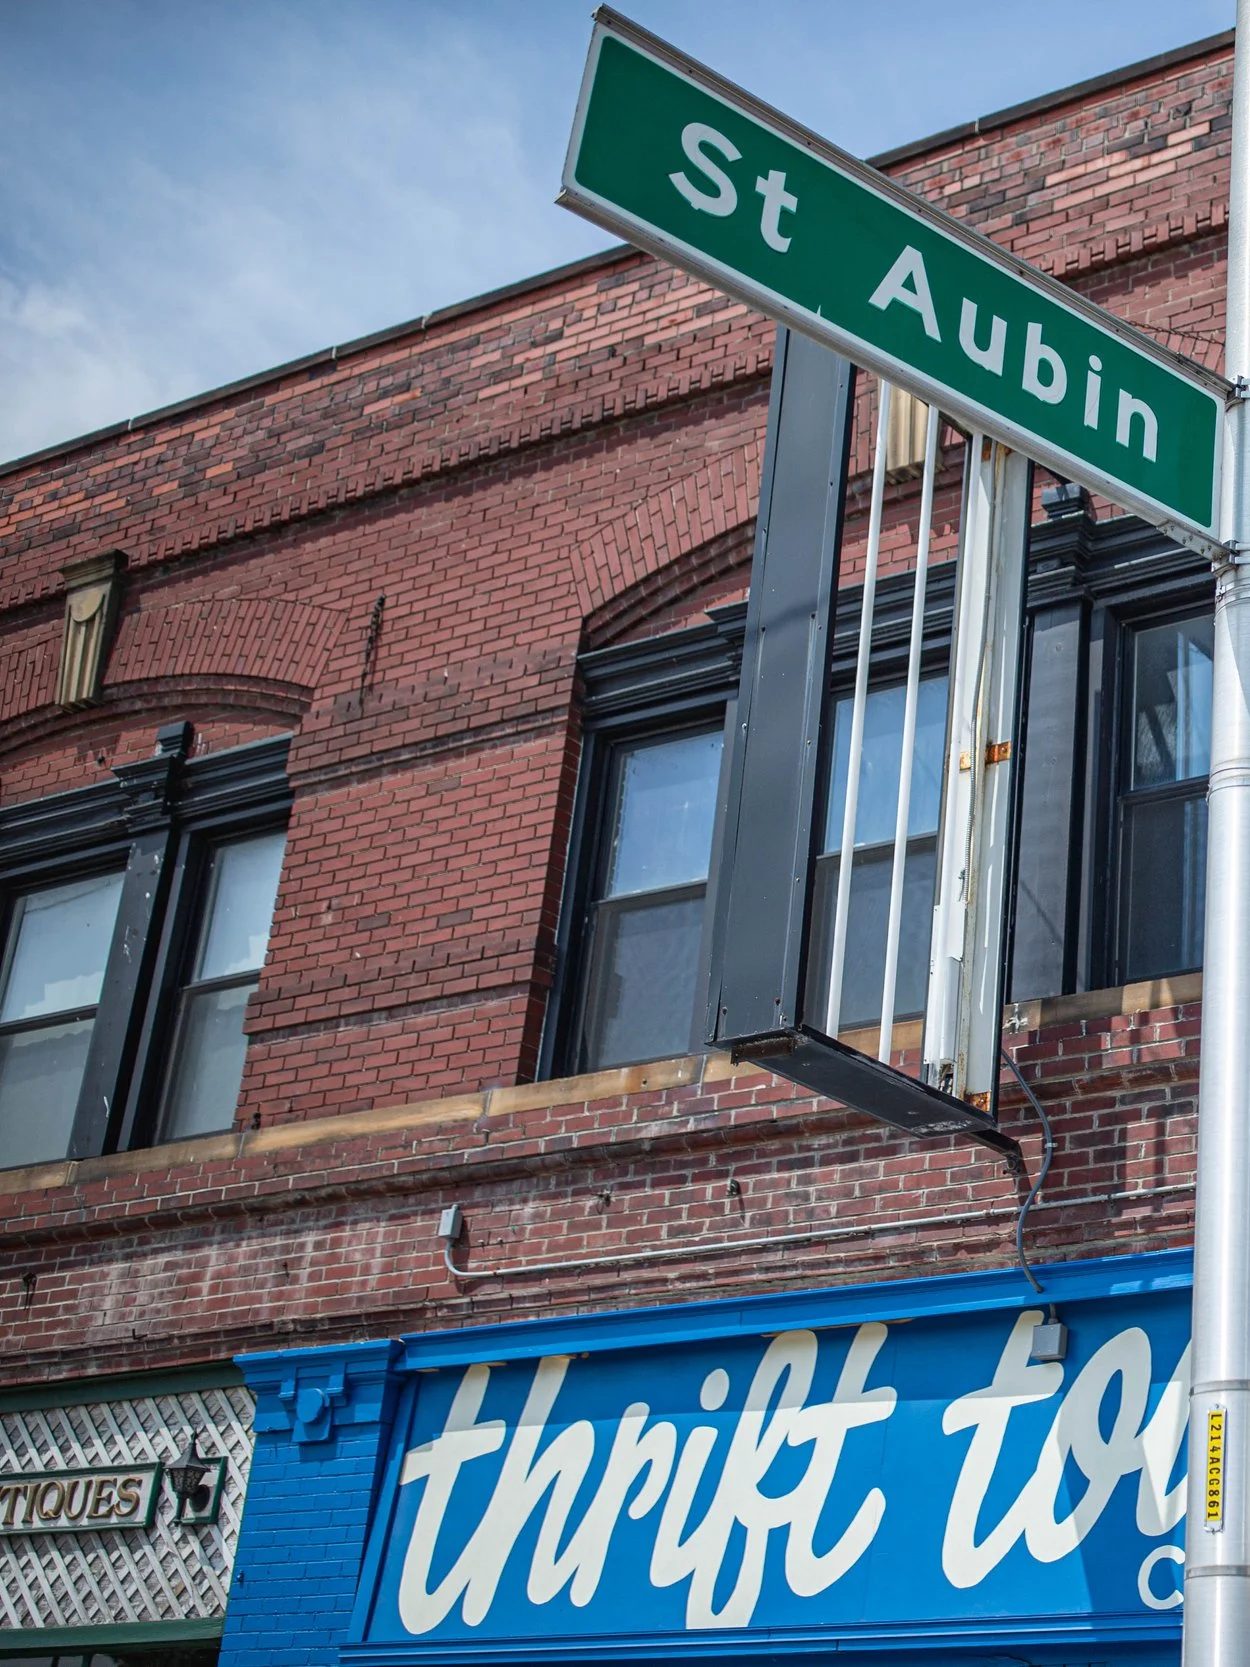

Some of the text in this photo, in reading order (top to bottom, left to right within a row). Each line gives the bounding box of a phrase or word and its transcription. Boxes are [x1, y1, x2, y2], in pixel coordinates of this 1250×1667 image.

[669, 122, 1159, 463] St Aubin
[0, 1477, 143, 1525] TIQUES
[398, 1321, 897, 1635] thrift
[1207, 1413, 1222, 1518] L214ACG861
